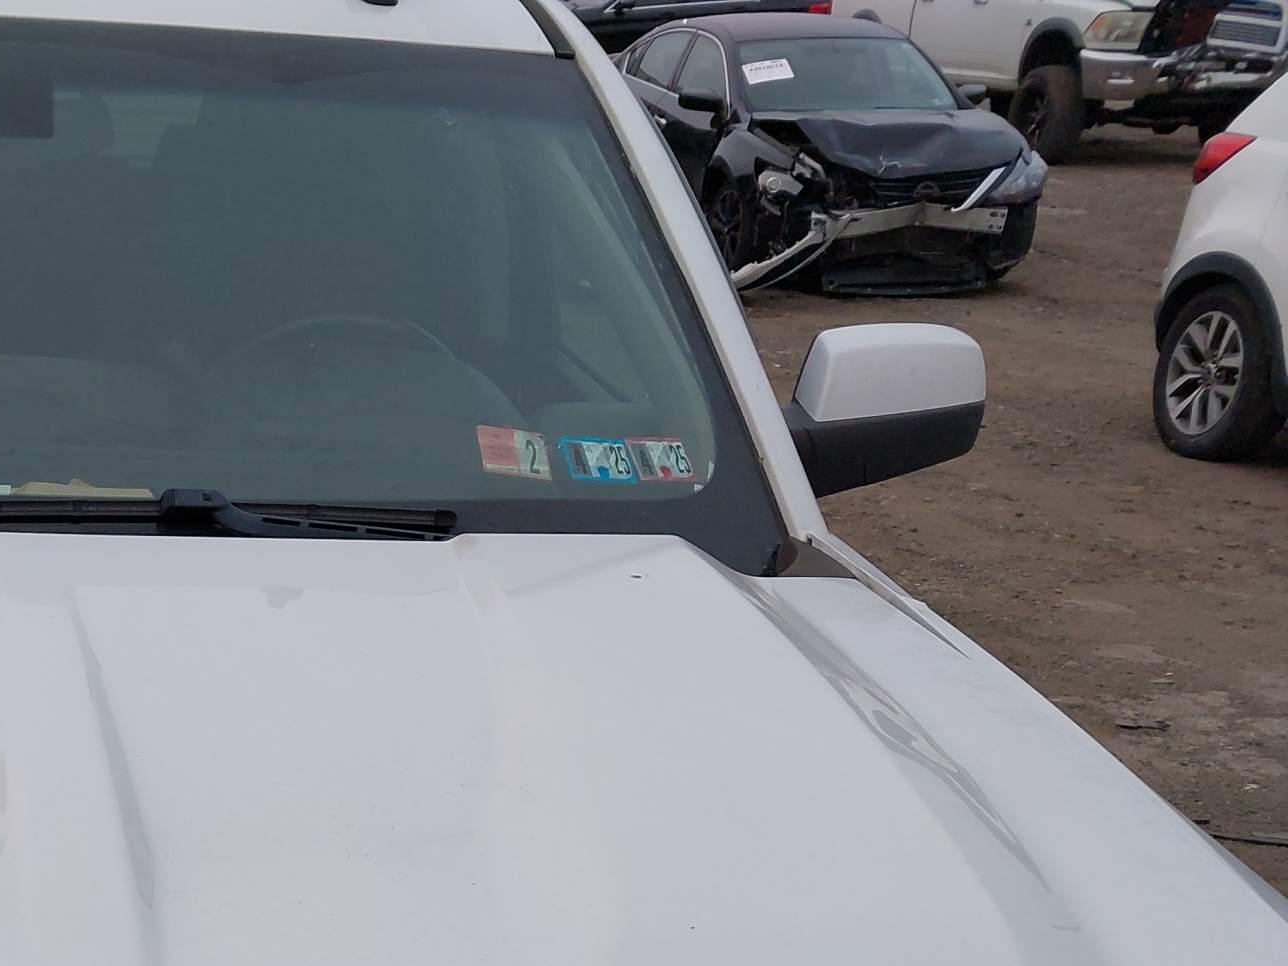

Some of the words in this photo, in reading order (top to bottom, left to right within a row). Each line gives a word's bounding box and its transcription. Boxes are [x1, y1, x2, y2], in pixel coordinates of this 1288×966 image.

[525, 439, 540, 474] 2
[609, 445, 631, 475] 25
[669, 444, 692, 474] 25
